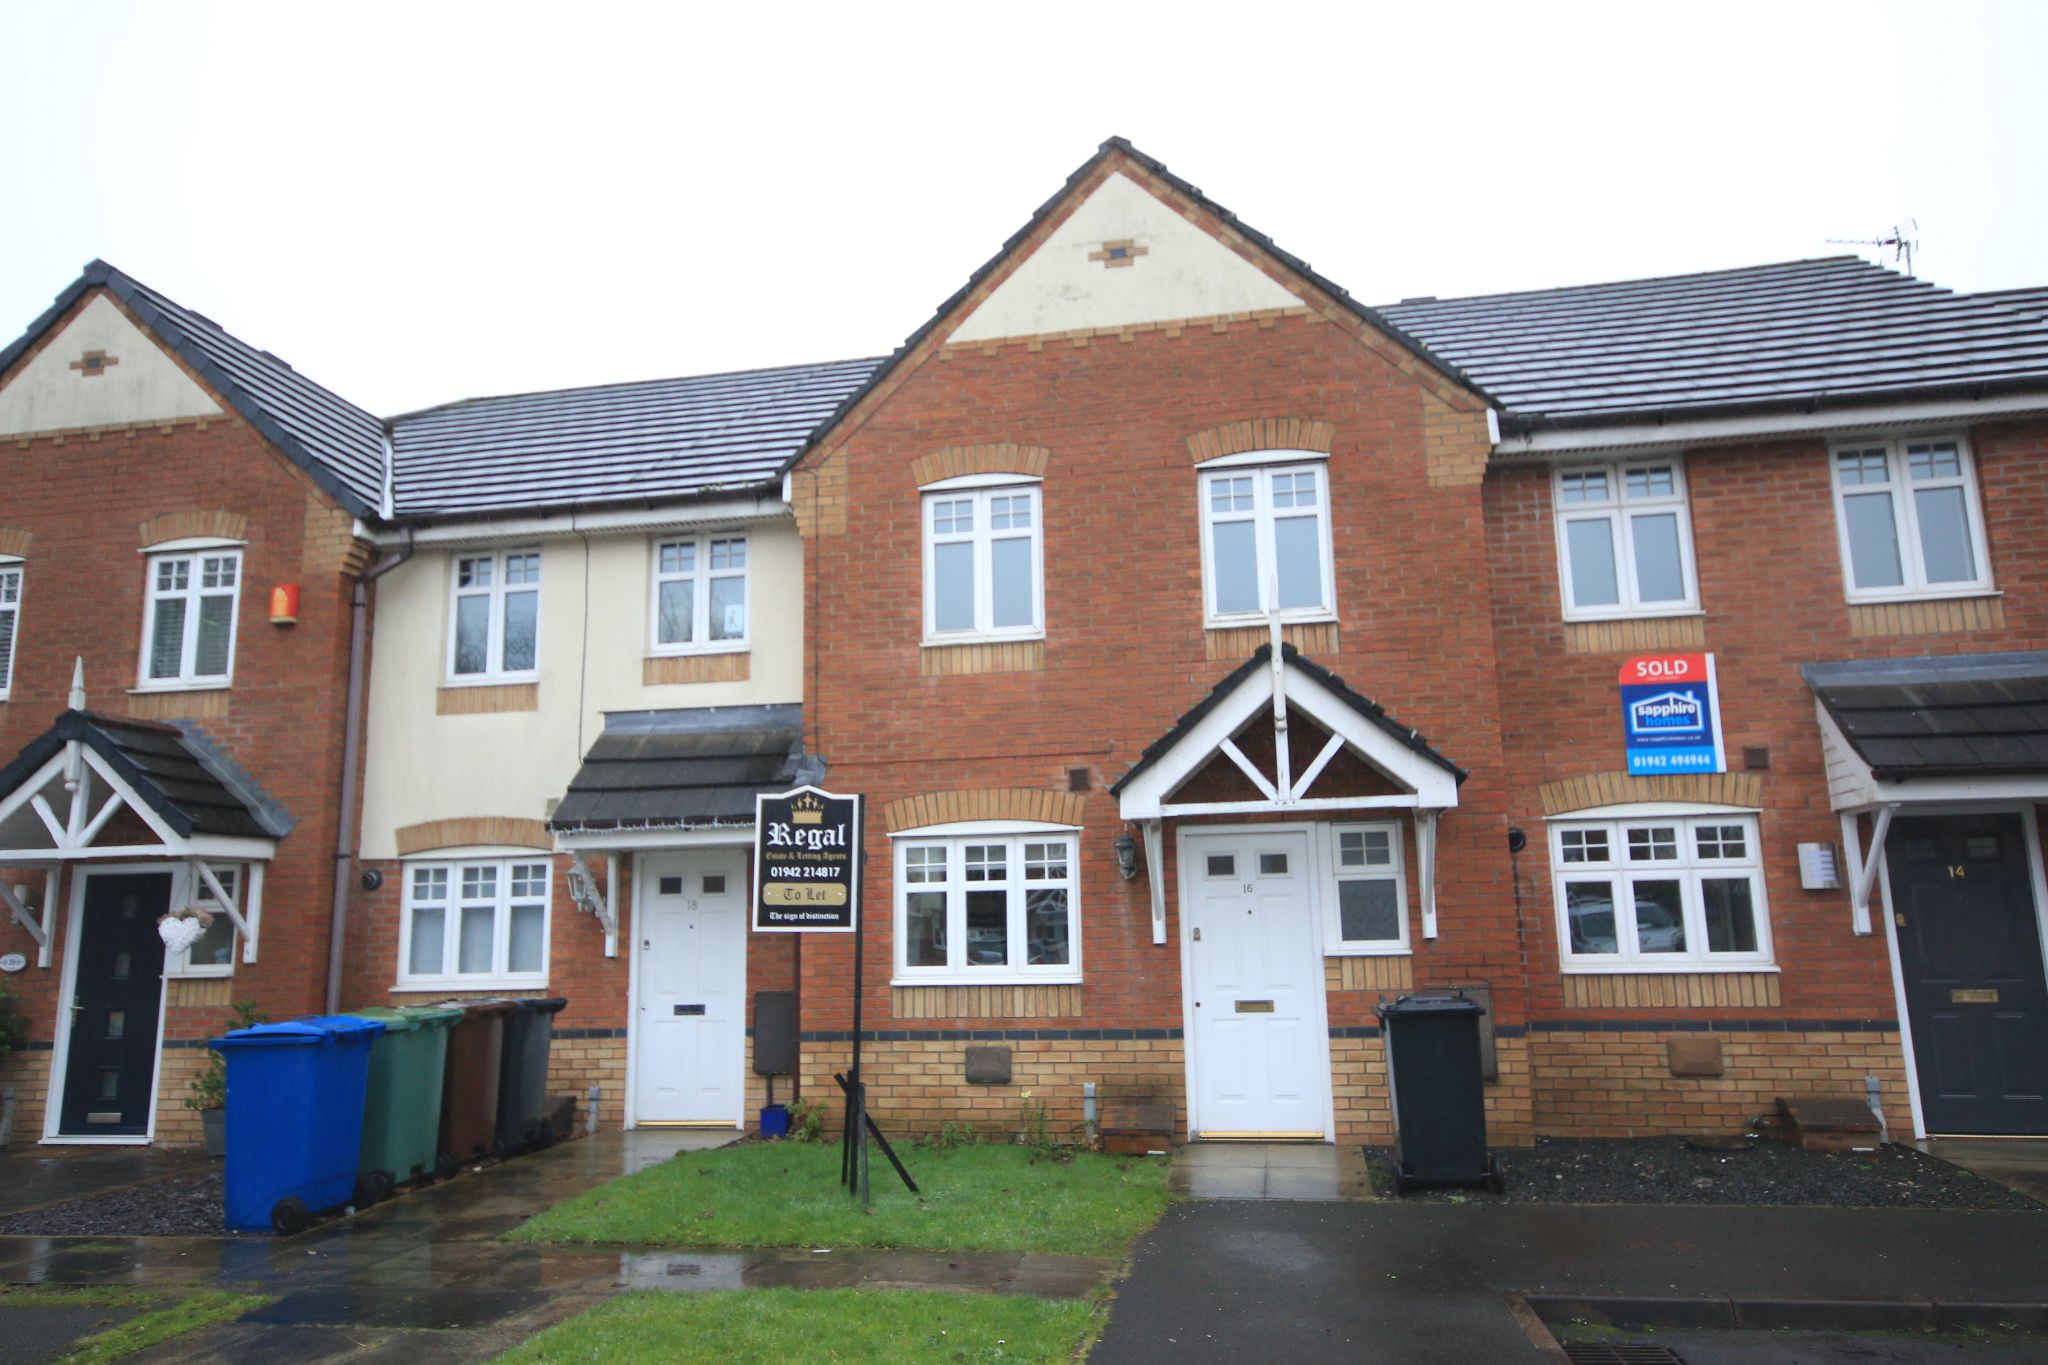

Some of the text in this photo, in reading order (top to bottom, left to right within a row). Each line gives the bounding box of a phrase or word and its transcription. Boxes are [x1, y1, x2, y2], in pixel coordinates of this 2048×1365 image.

[1637, 660, 1688, 677] SOLD
[1638, 700, 1696, 717] sapphire
[1646, 716, 1690, 726] homes
[1634, 756, 1667, 767] 01942
[767, 822, 846, 850] Regal
[770, 866, 841, 878] 01942 214817
[1947, 865, 1966, 879] 14
[783, 887, 827, 901] To Let
[1243, 883, 1253, 894] 16
[687, 899, 698, 911] 18
[769, 911, 839, 922] The sign of distinction
